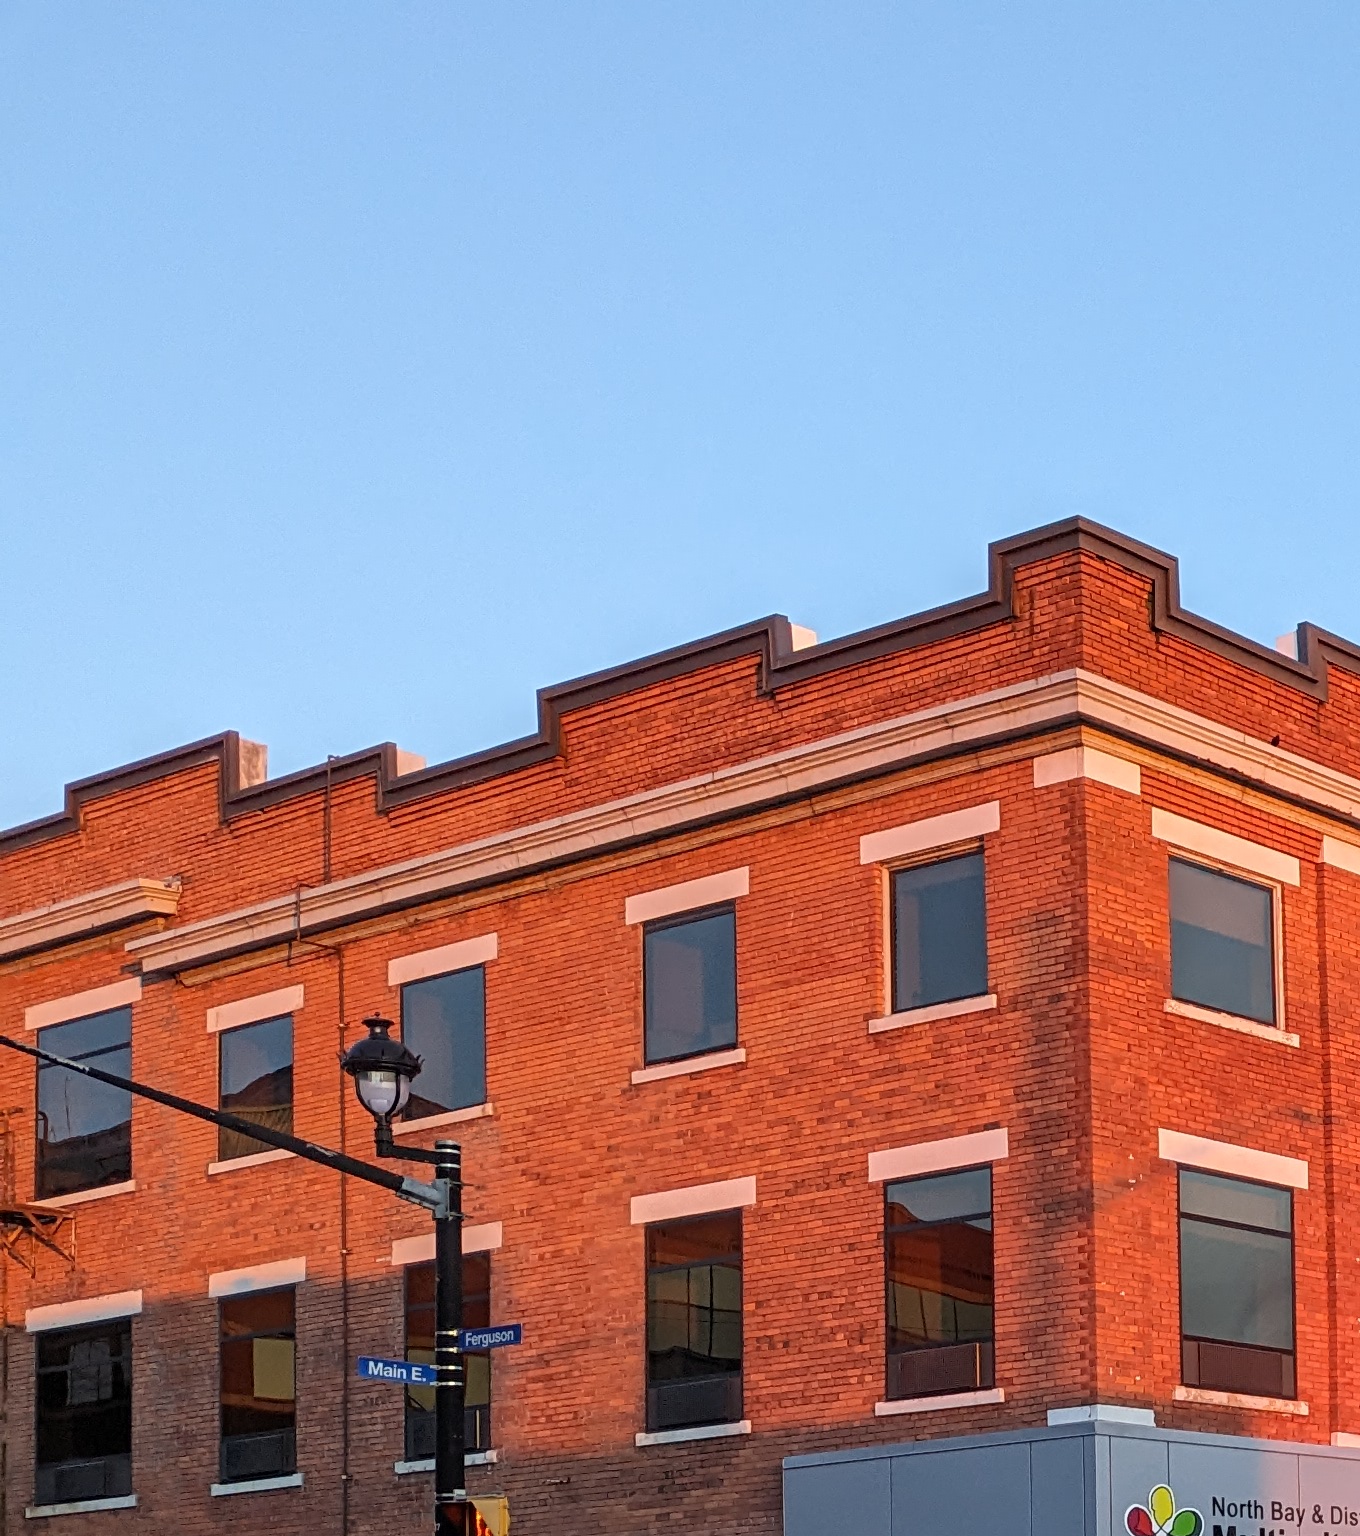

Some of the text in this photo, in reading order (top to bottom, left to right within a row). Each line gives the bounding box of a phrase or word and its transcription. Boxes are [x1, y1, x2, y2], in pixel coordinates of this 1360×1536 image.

[465, 1330, 514, 1349] Ferguson
[368, 1361, 427, 1382] Main E.
[1211, 1496, 1264, 1520] North
[1271, 1501, 1305, 1527] Bay
[1311, 1504, 1324, 1524] &
